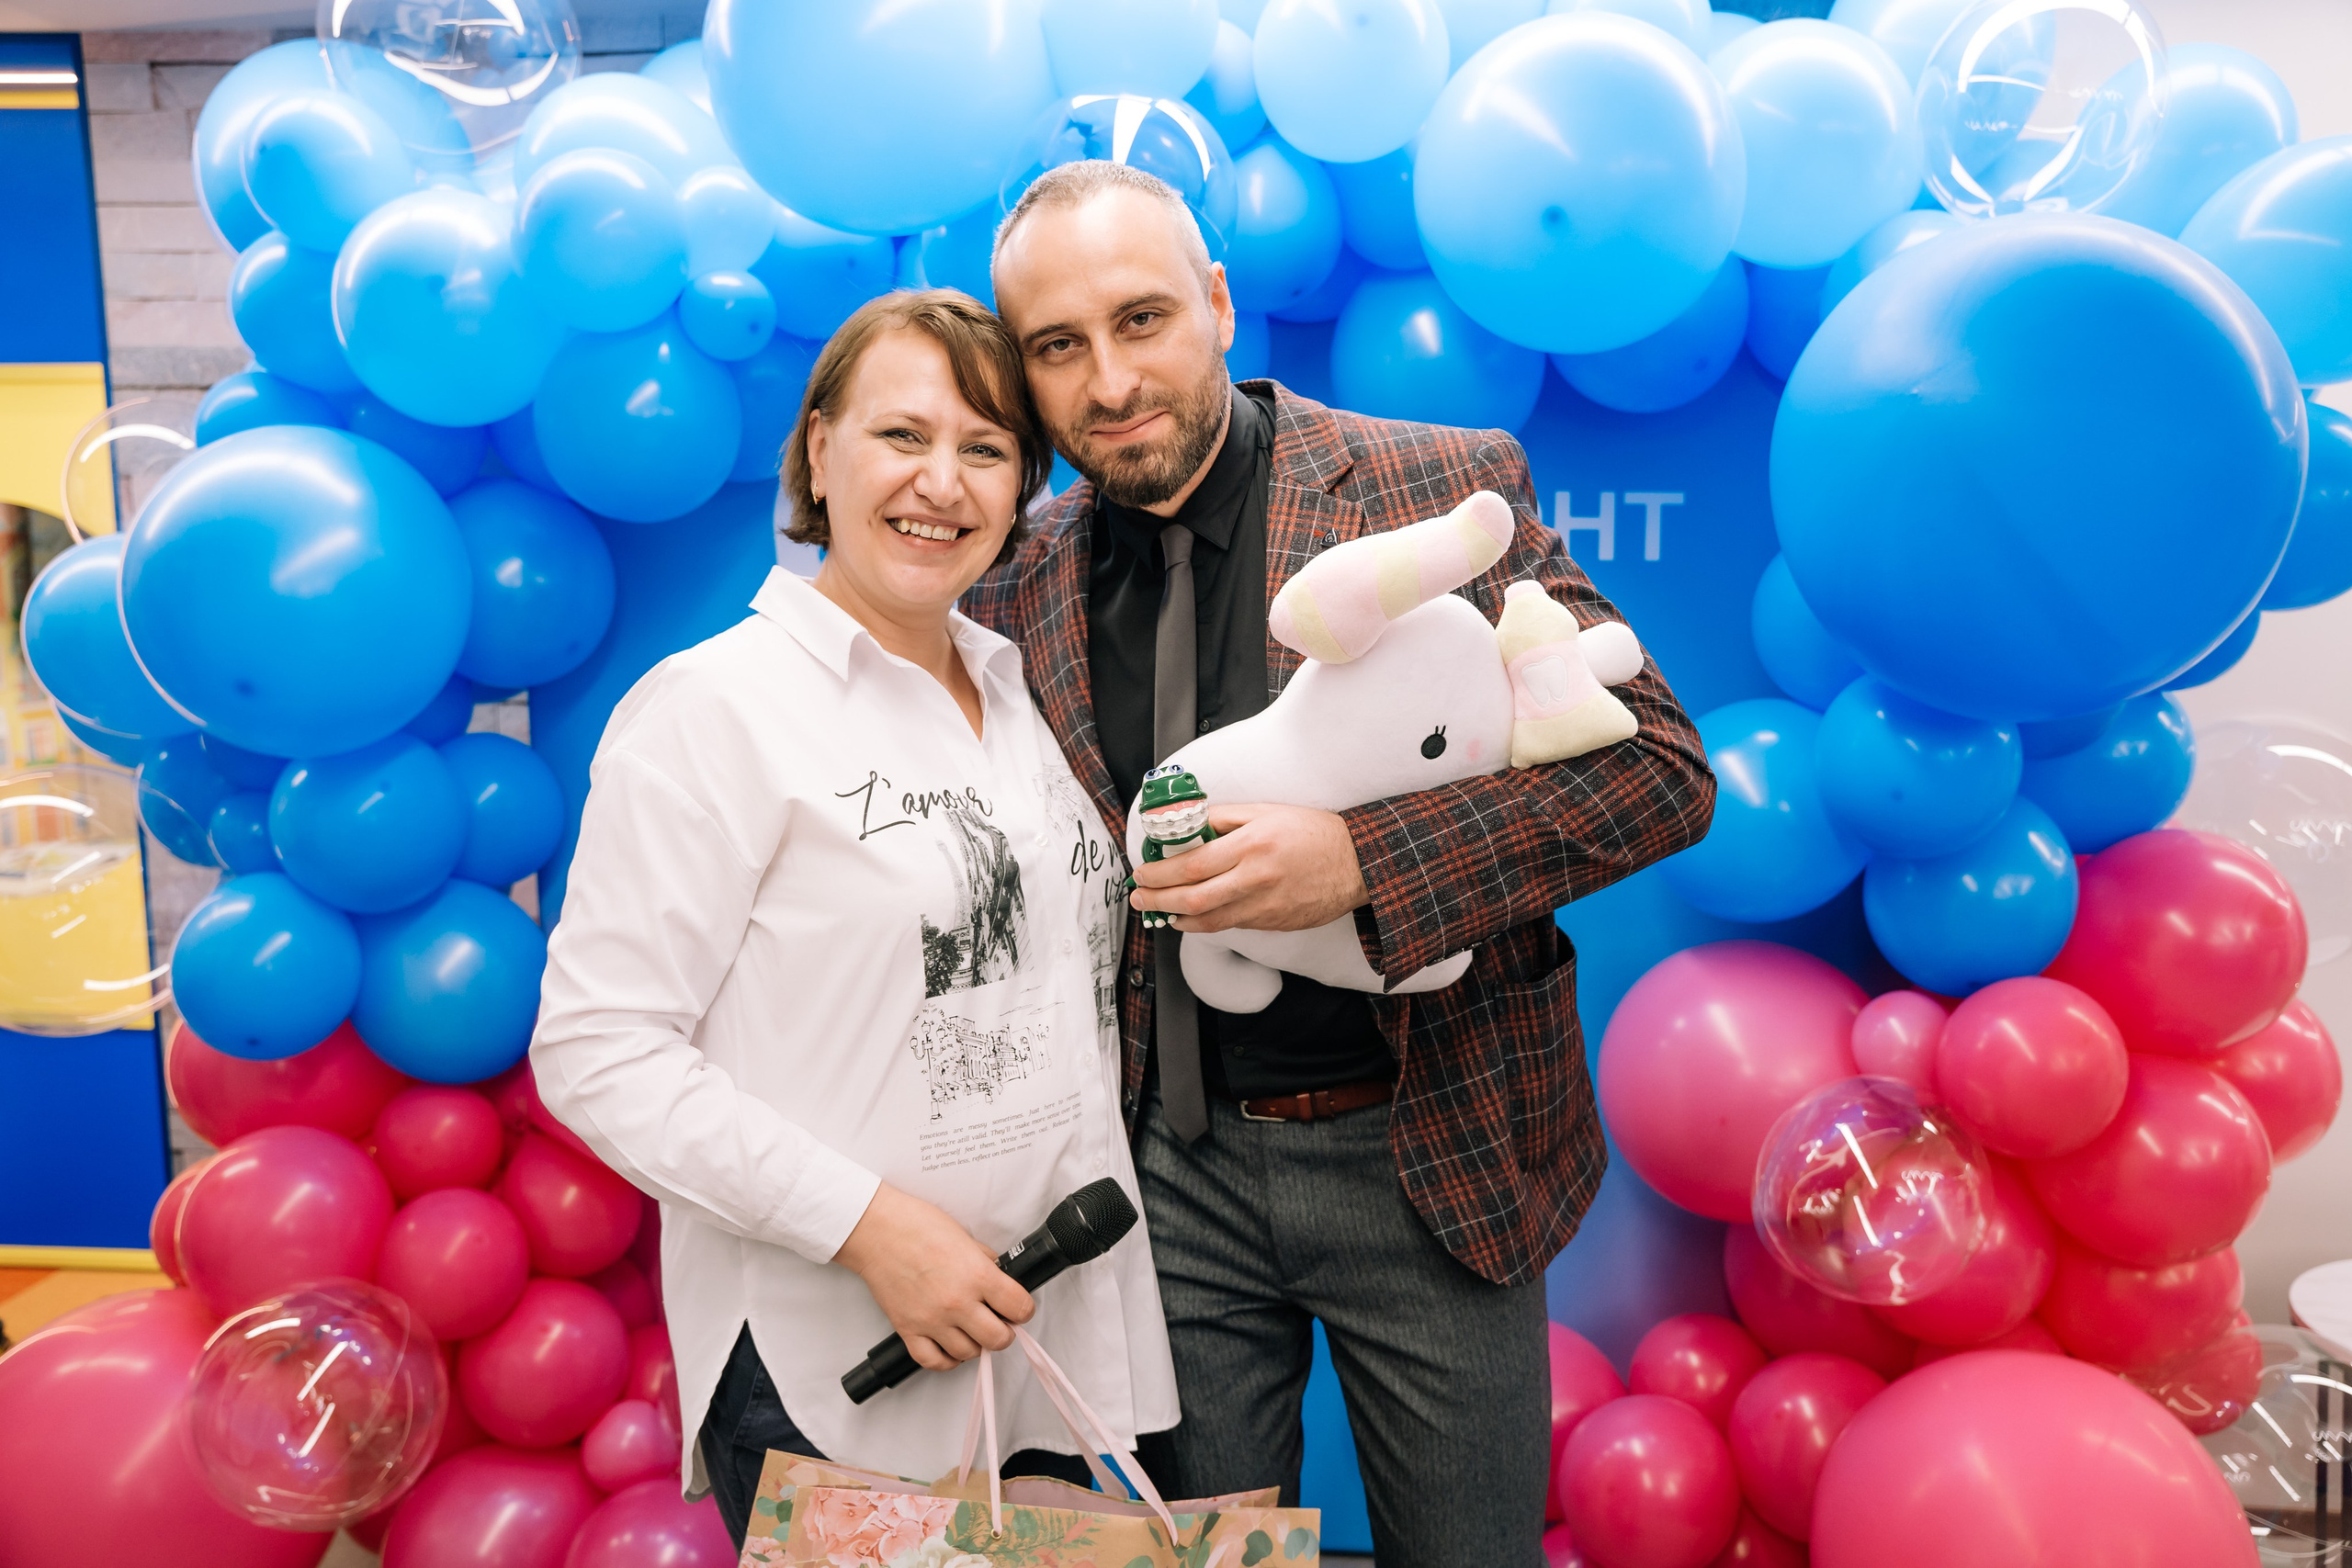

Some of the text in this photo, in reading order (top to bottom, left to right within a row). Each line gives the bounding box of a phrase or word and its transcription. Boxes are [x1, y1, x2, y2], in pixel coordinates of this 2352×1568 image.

[1070, 819, 1104, 884] de
[919, 1130, 948, 1141] Emotions
[967, 1122, 988, 1131] messy
[1028, 1107, 1040, 1116] Just
[1044, 1102, 1056, 1111] here
[933, 1139, 956, 1148] they're
[990, 1125, 1012, 1136] They'll
[1014, 1121, 1031, 1131] make
[1031, 1116, 1046, 1125] more
[1046, 1111, 1060, 1121] sense
[1061, 1106, 1071, 1114] over
[935, 1147, 961, 1159] yourself
[964, 1145, 976, 1154] feel
[979, 1141, 997, 1150] them.
[1000, 1135, 1018, 1145] Write
[1021, 1130, 1036, 1139] them
[1052, 1118, 1070, 1129] Release
[921, 1164, 940, 1173] Judge
[940, 1159, 956, 1168] them
[971, 1153, 991, 1163] reflect
[1001, 1145, 1016, 1156] them
